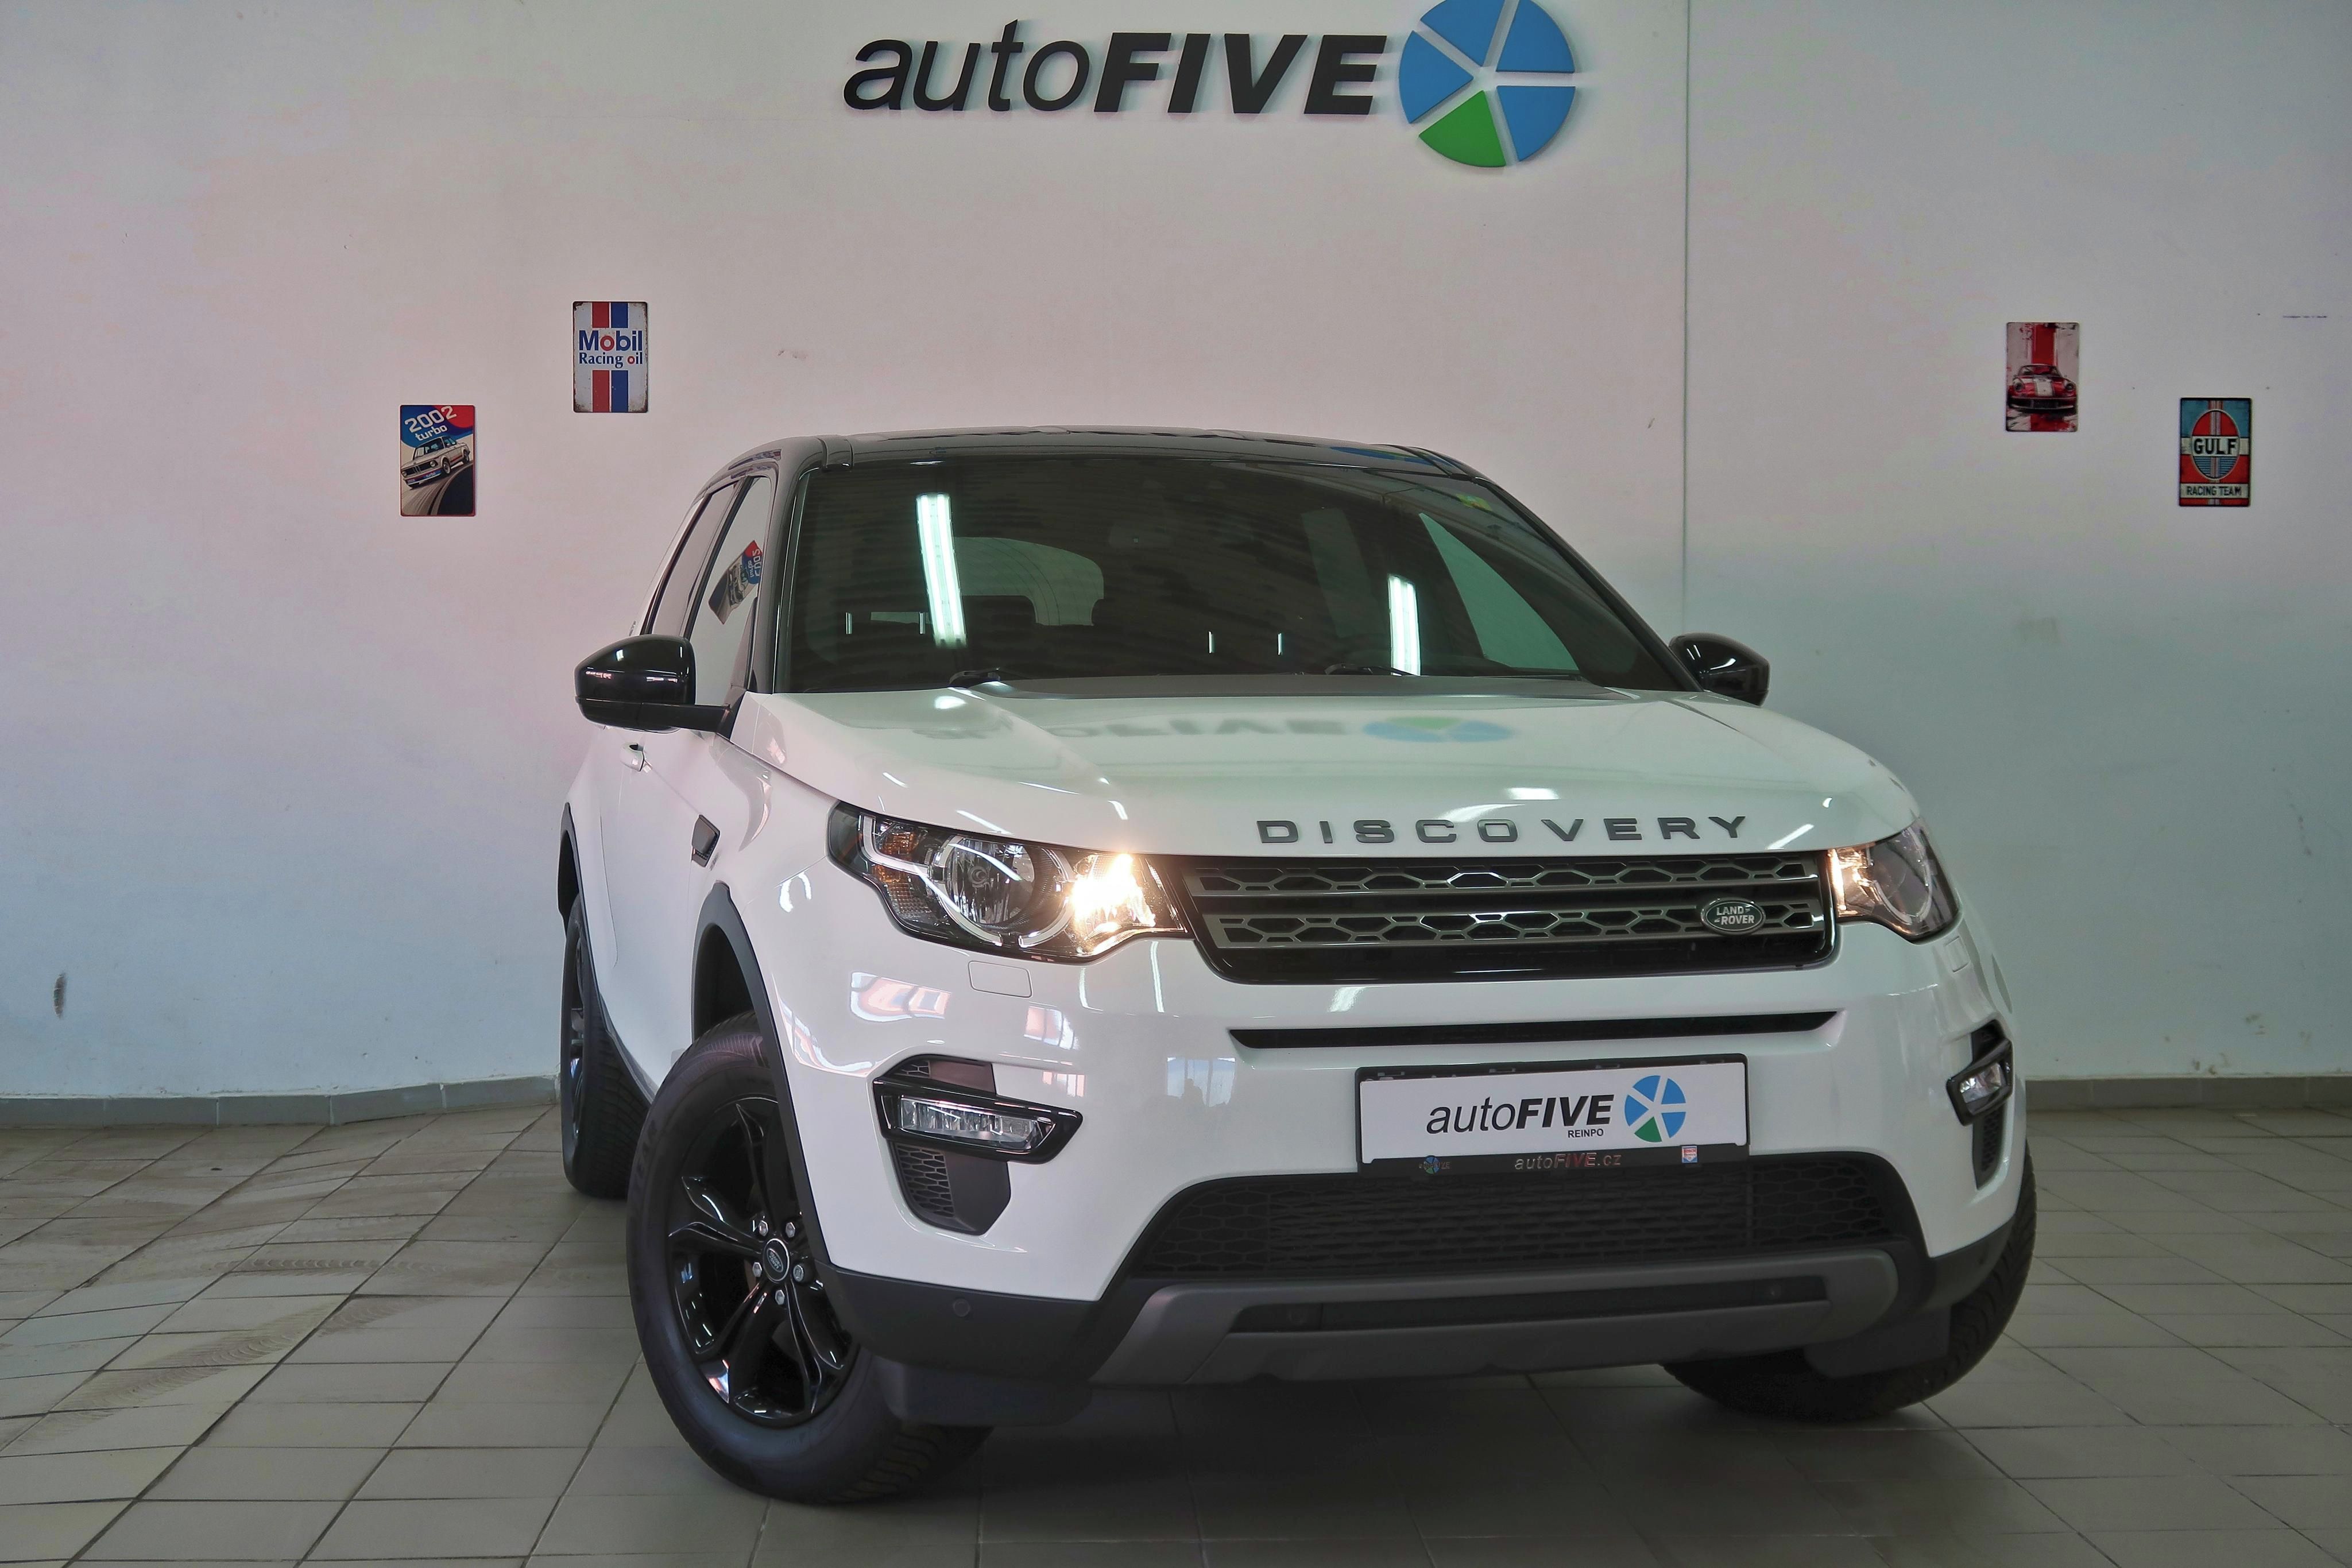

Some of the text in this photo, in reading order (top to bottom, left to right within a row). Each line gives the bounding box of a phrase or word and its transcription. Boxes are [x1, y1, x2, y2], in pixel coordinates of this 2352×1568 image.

[842, 18, 1388, 115] autoFIVE
[578, 330, 643, 351] Mobil
[579, 351, 643, 369] Racing oil
[404, 405, 457, 433] 2002
[415, 425, 447, 441] turbo
[2194, 438, 2238, 455] GULF
[2187, 486, 2242, 496] RACING TEAM
[1256, 815, 1746, 844] DISCOVERY
[1716, 905, 1744, 916] LAND
[1720, 915, 1755, 925] ROVER
[1426, 1094, 1615, 1135] autoFIVE
[1567, 1127, 1604, 1139] REINPO
[1514, 1152, 1622, 1170] autoFIVE.cz
